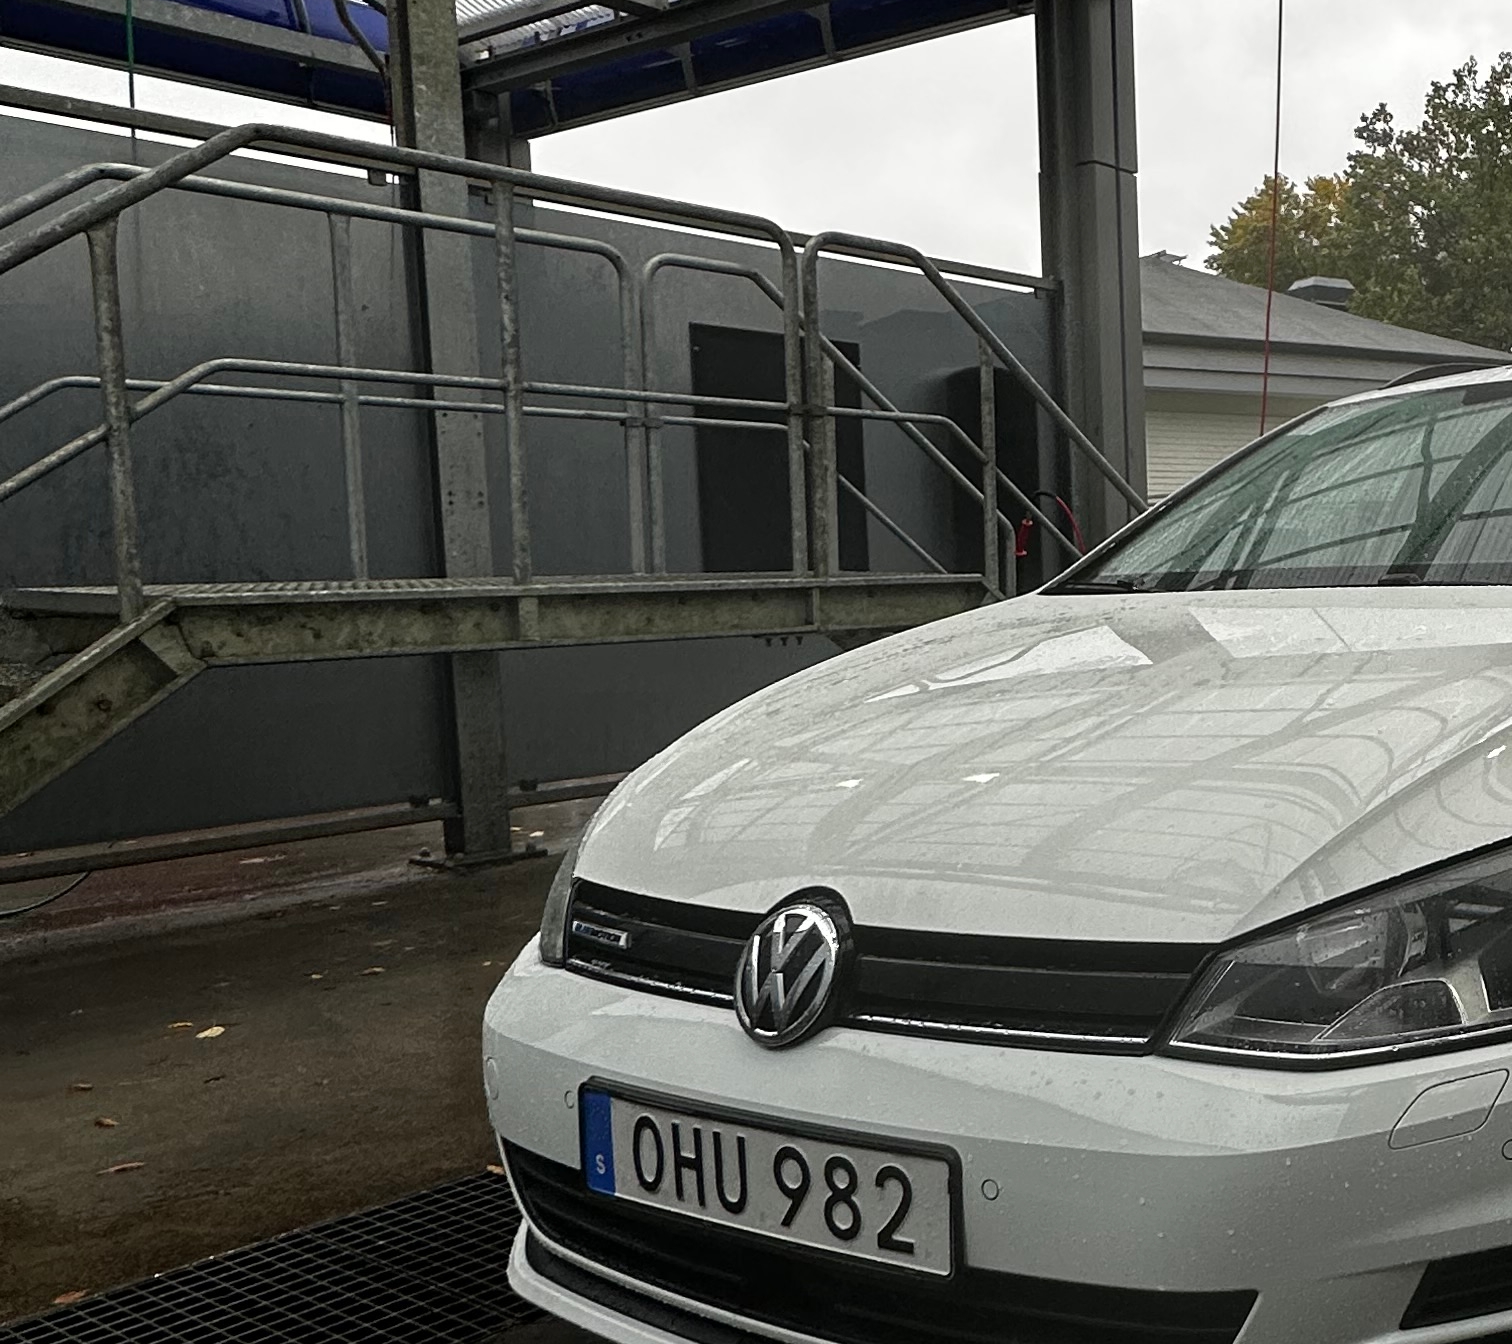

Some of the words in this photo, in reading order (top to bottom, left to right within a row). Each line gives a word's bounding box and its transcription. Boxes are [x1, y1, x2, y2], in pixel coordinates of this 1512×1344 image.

[596, 1154, 606, 1175] S
[632, 1115, 748, 1215] OHU
[773, 1146, 916, 1254] 982
